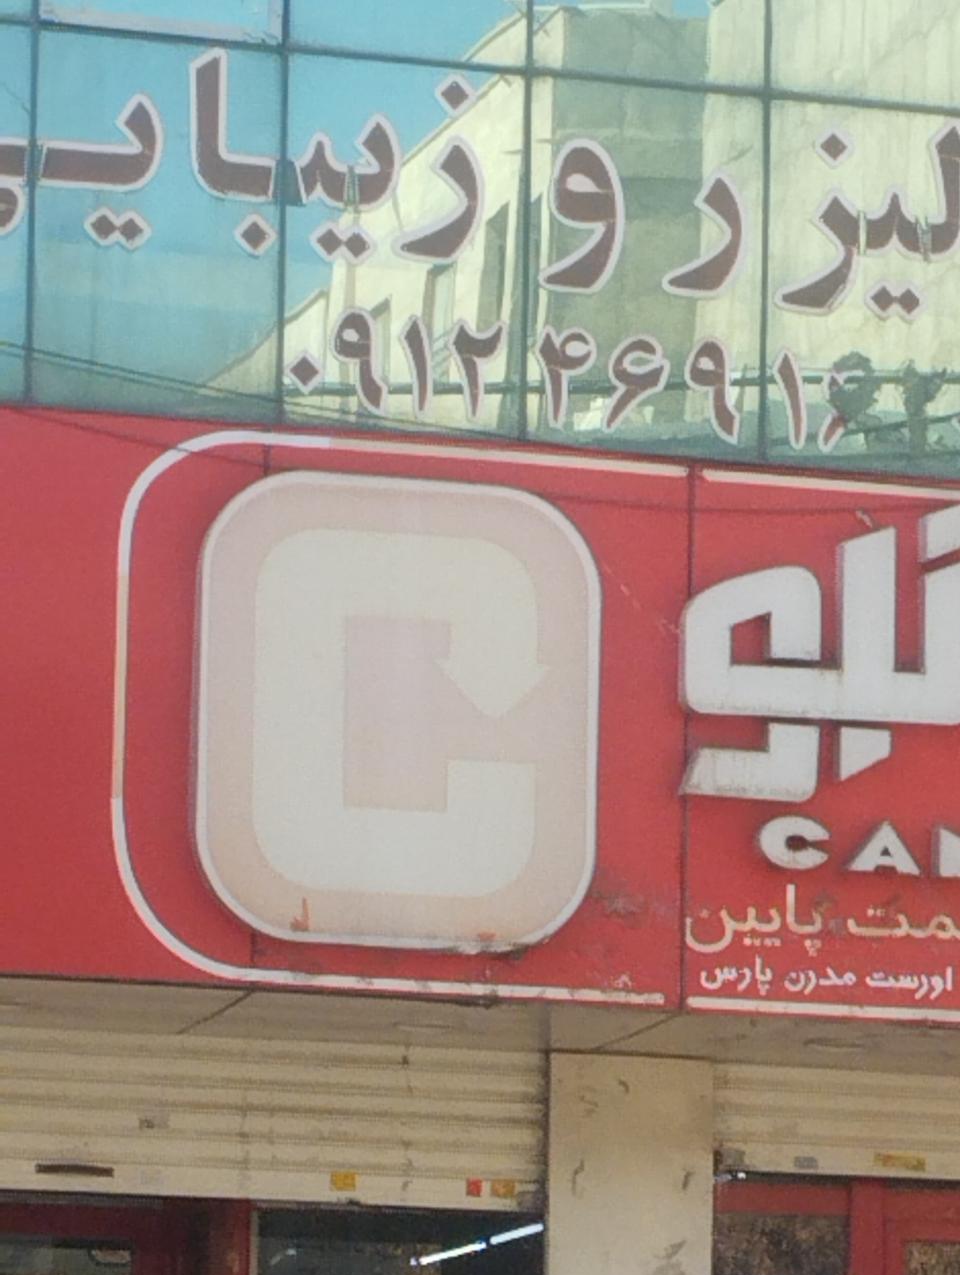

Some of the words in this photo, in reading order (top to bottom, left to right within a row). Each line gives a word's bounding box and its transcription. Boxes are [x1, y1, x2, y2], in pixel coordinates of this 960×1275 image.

[0, 46, 485, 262] زیبای
[684, 883, 824, 956] پایین
[700, 953, 773, 996] پارس
[783, 965, 857, 995] مدرن
[865, 965, 953, 1000] اورست
